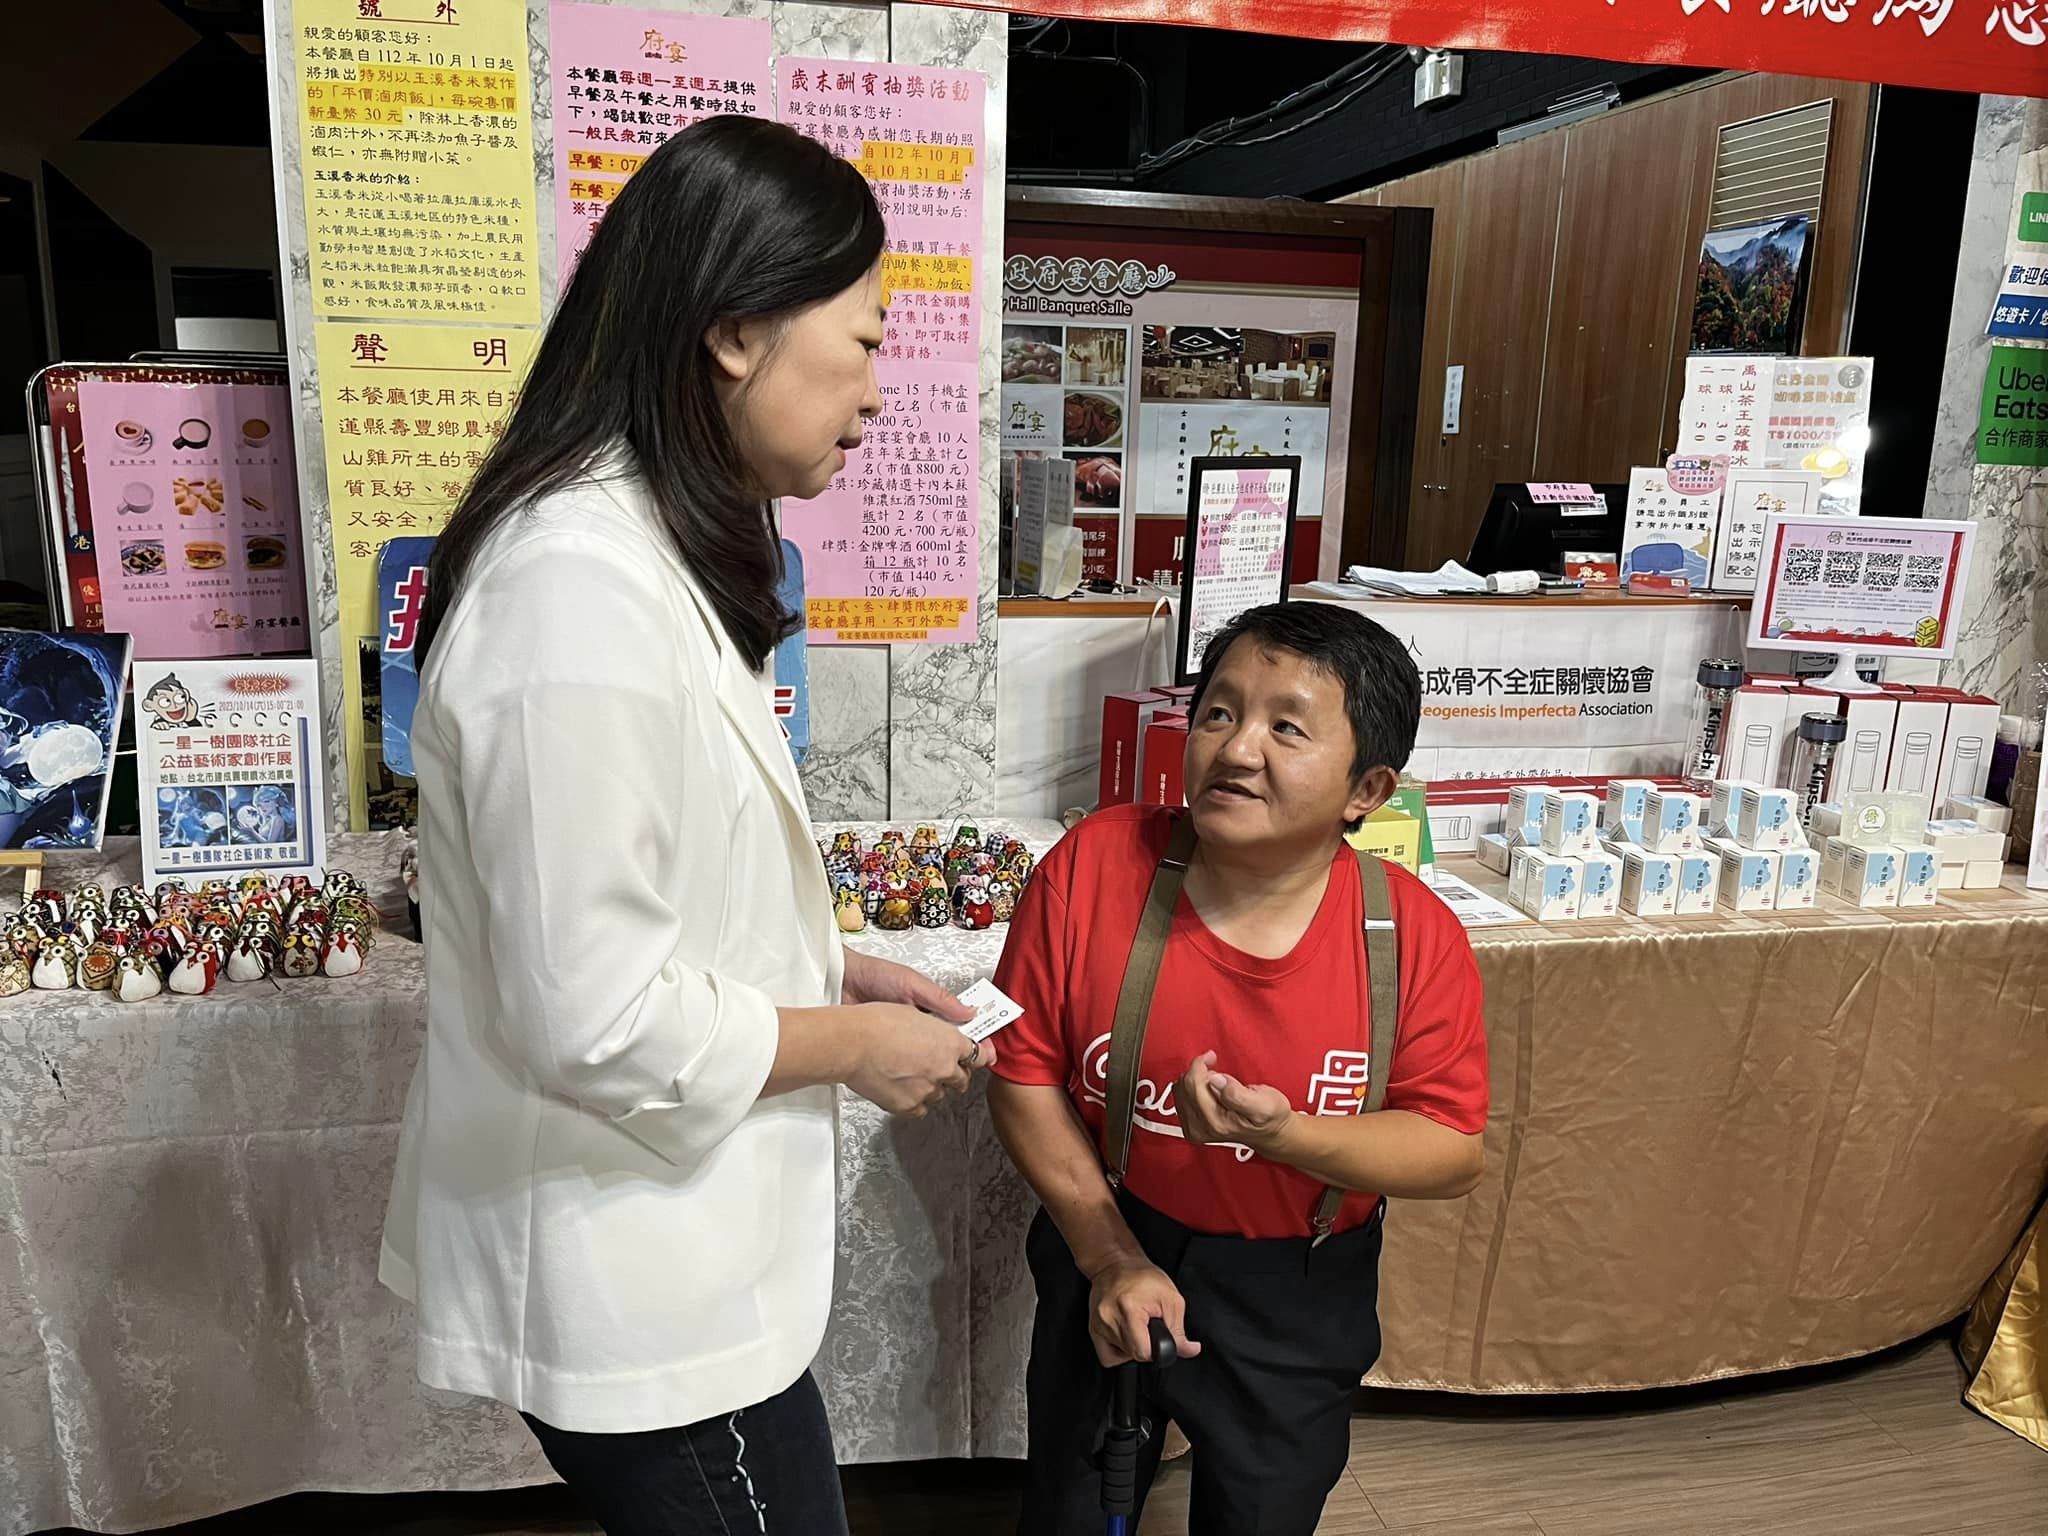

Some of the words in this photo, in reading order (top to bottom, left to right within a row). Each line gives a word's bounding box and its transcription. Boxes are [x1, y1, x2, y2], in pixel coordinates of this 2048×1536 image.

[567, 66, 756, 95] 本餐廳每週一至週五提供
[791, 68, 970, 102] 歲末酬賓抽獎活動
[568, 86, 755, 113] 早餐及午餐之用餐時段如
[570, 154, 643, 172] 早餐：07
[1010, 298, 1036, 312] Hall
[1039, 299, 1097, 316] Banquet
[1100, 302, 1132, 316] Salle
[1994, 395, 2048, 419] Eats
[1985, 427, 2048, 448] 合作商家
[344, 480, 473, 498] 質良好、營
[1500, 704, 1576, 720] Imperfecta
[1579, 701, 1653, 717] Association
[159, 734, 292, 750] 一星一樹團隊社企
[1701, 708, 1722, 770] Klipsch
[160, 751, 292, 769] 公益藝術家創作展
